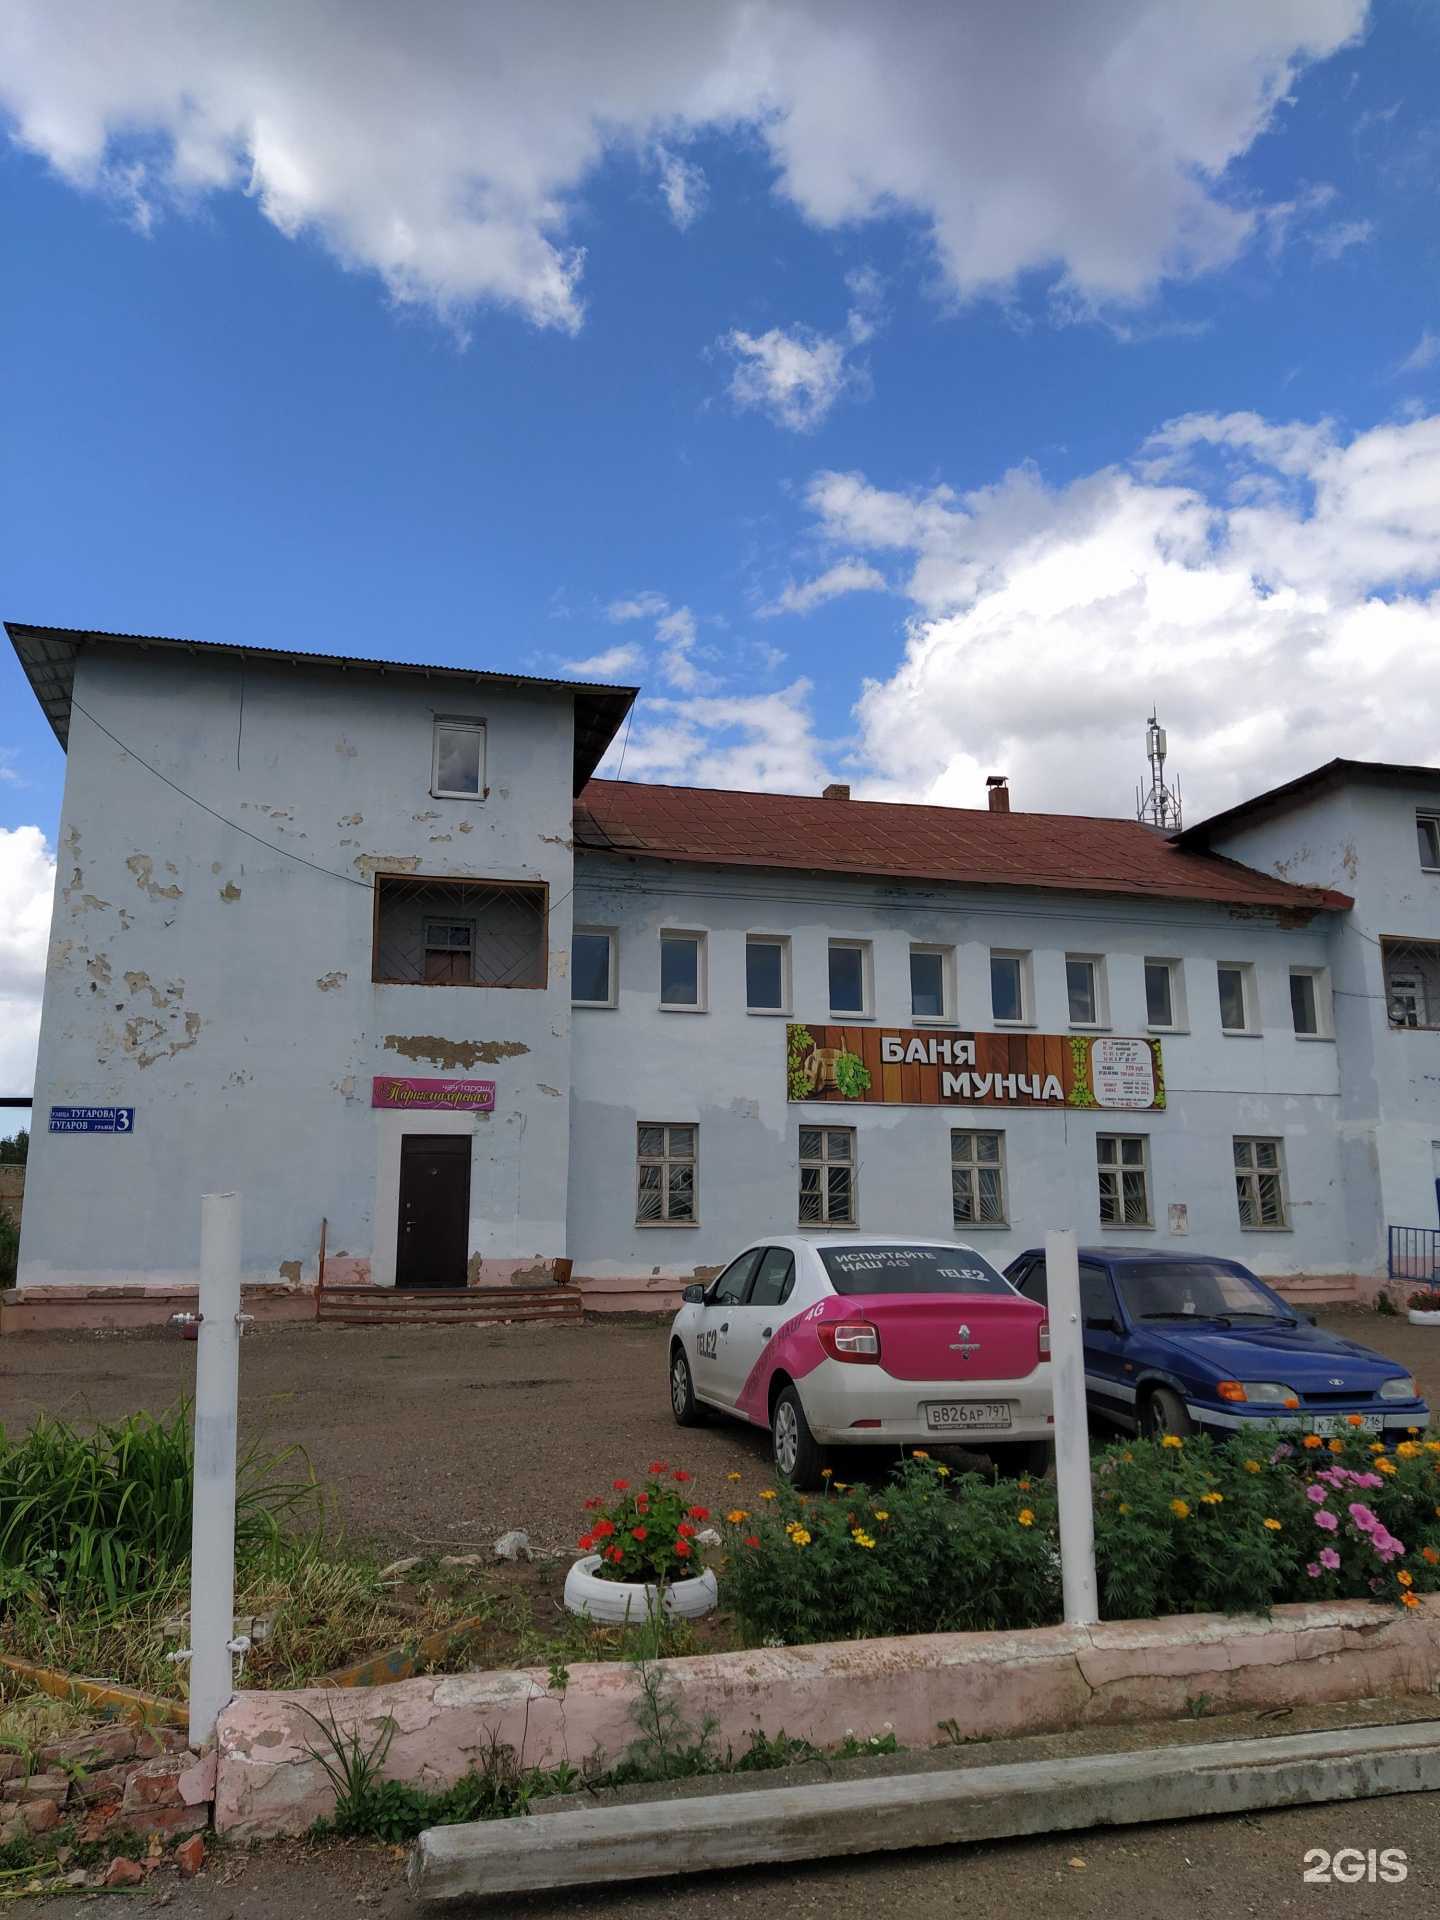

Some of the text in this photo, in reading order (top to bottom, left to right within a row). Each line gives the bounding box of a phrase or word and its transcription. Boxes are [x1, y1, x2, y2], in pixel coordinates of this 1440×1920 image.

[881, 1036, 976, 1065] БАНЯ
[942, 1071, 1065, 1100] МУНЧА
[71, 1109, 114, 1118] ТУГАРОВА
[117, 1110, 129, 1131] 3
[51, 1121, 88, 1130] ТУГАРОВ
[835, 1251, 936, 1263] ИСПЫТАЙТЕ
[841, 1259, 910, 1272] НАШ 4G
[936, 1269, 990, 1282] TELE2
[805, 1302, 824, 1321] 4G
[696, 1329, 717, 1356] TELE2
